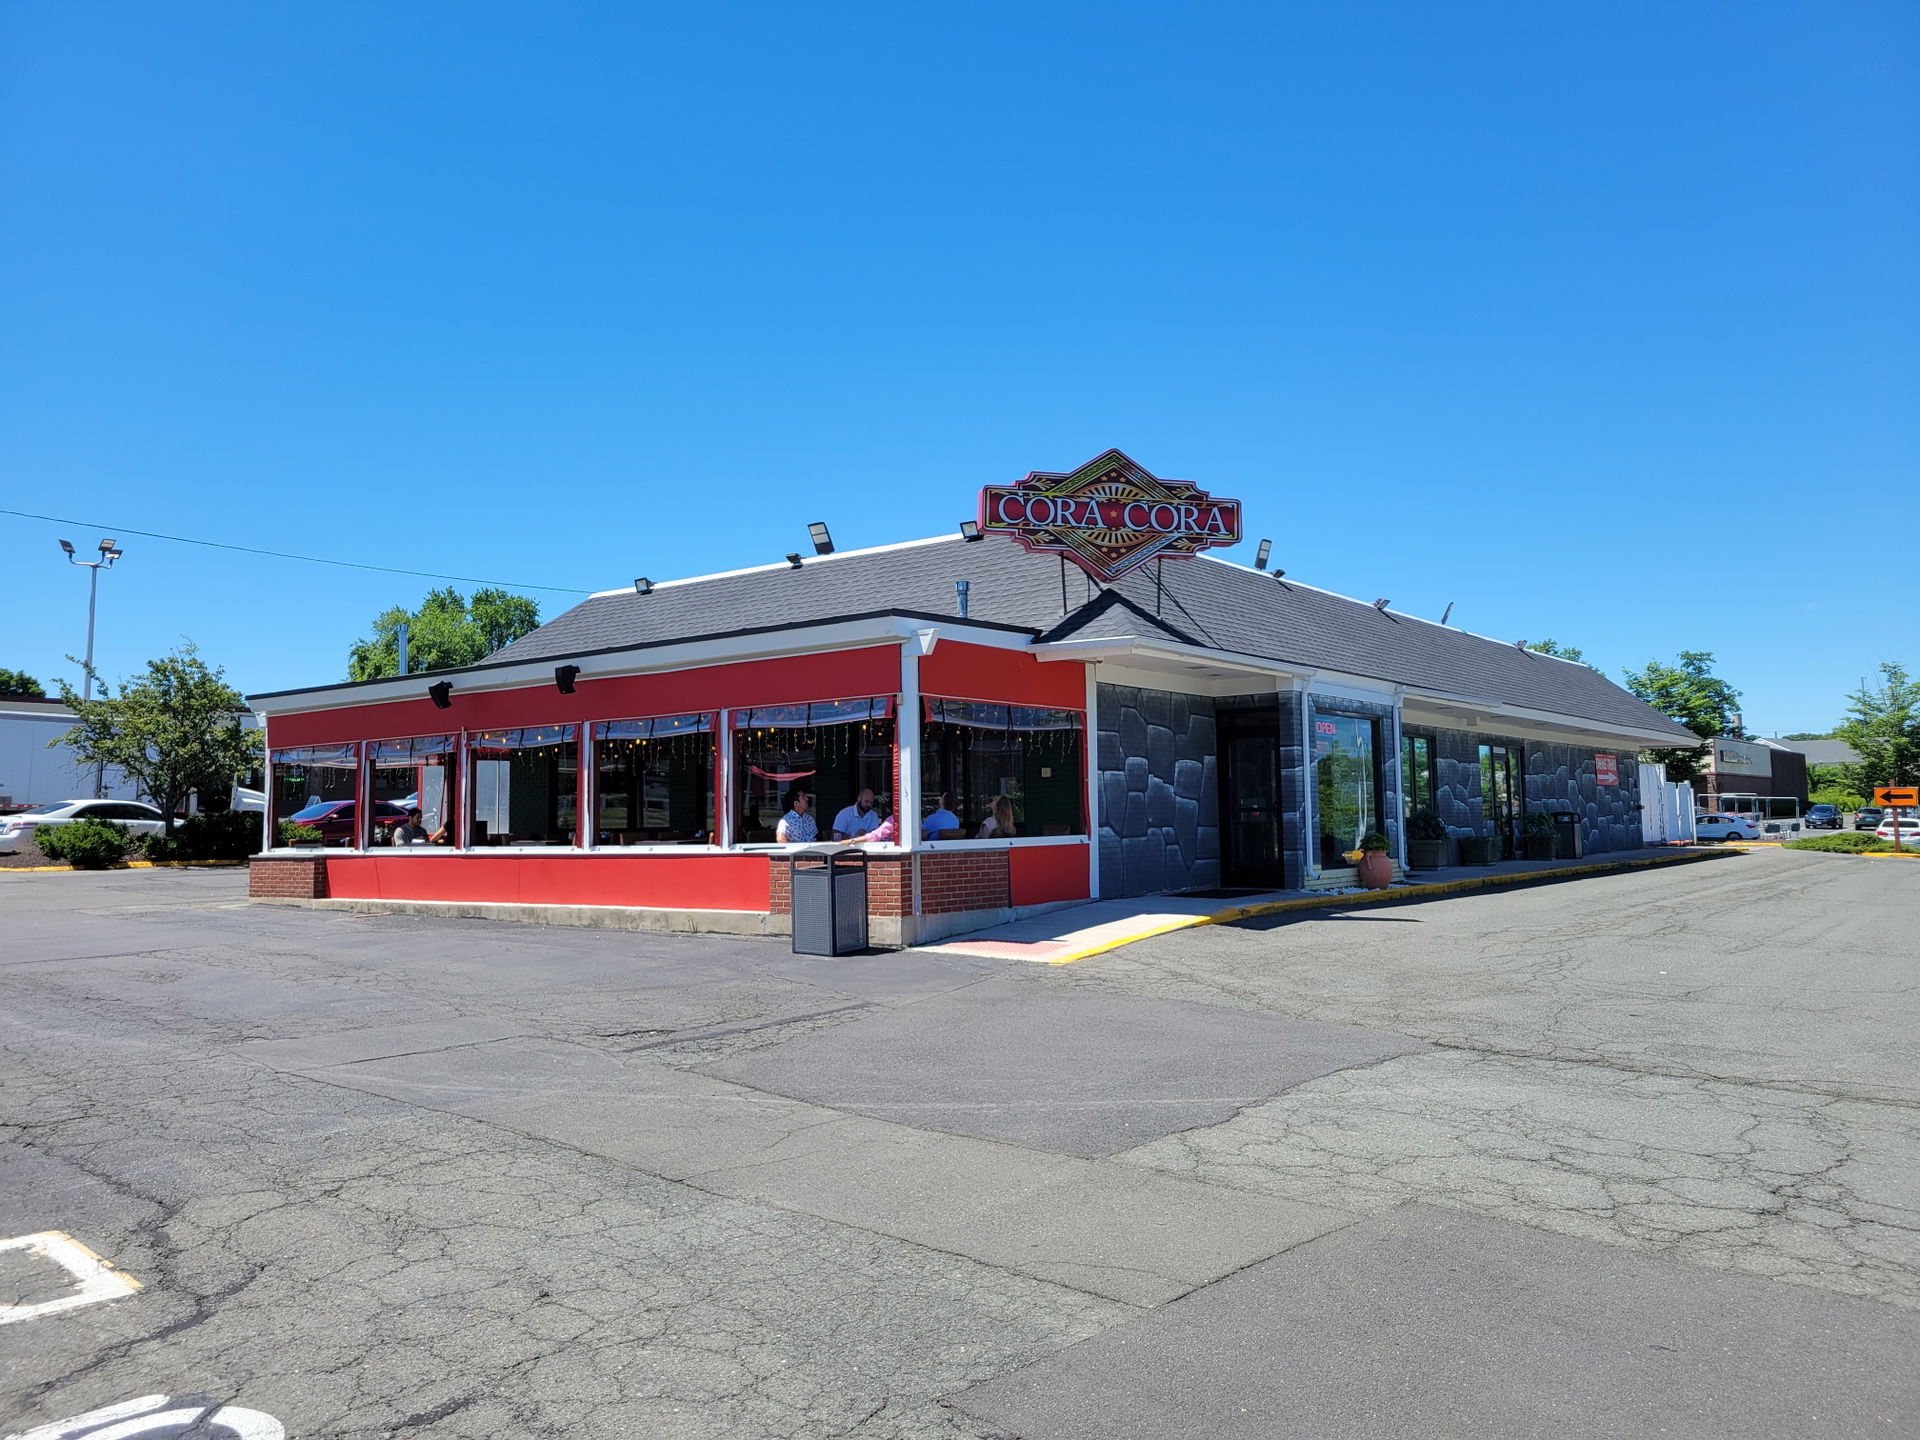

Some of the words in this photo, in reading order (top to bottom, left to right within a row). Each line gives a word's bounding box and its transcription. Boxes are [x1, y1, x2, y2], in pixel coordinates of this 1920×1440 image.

[998, 495, 1108, 528] CORA
[1123, 502, 1230, 535] CORA
[1315, 721, 1336, 734] OPEN
